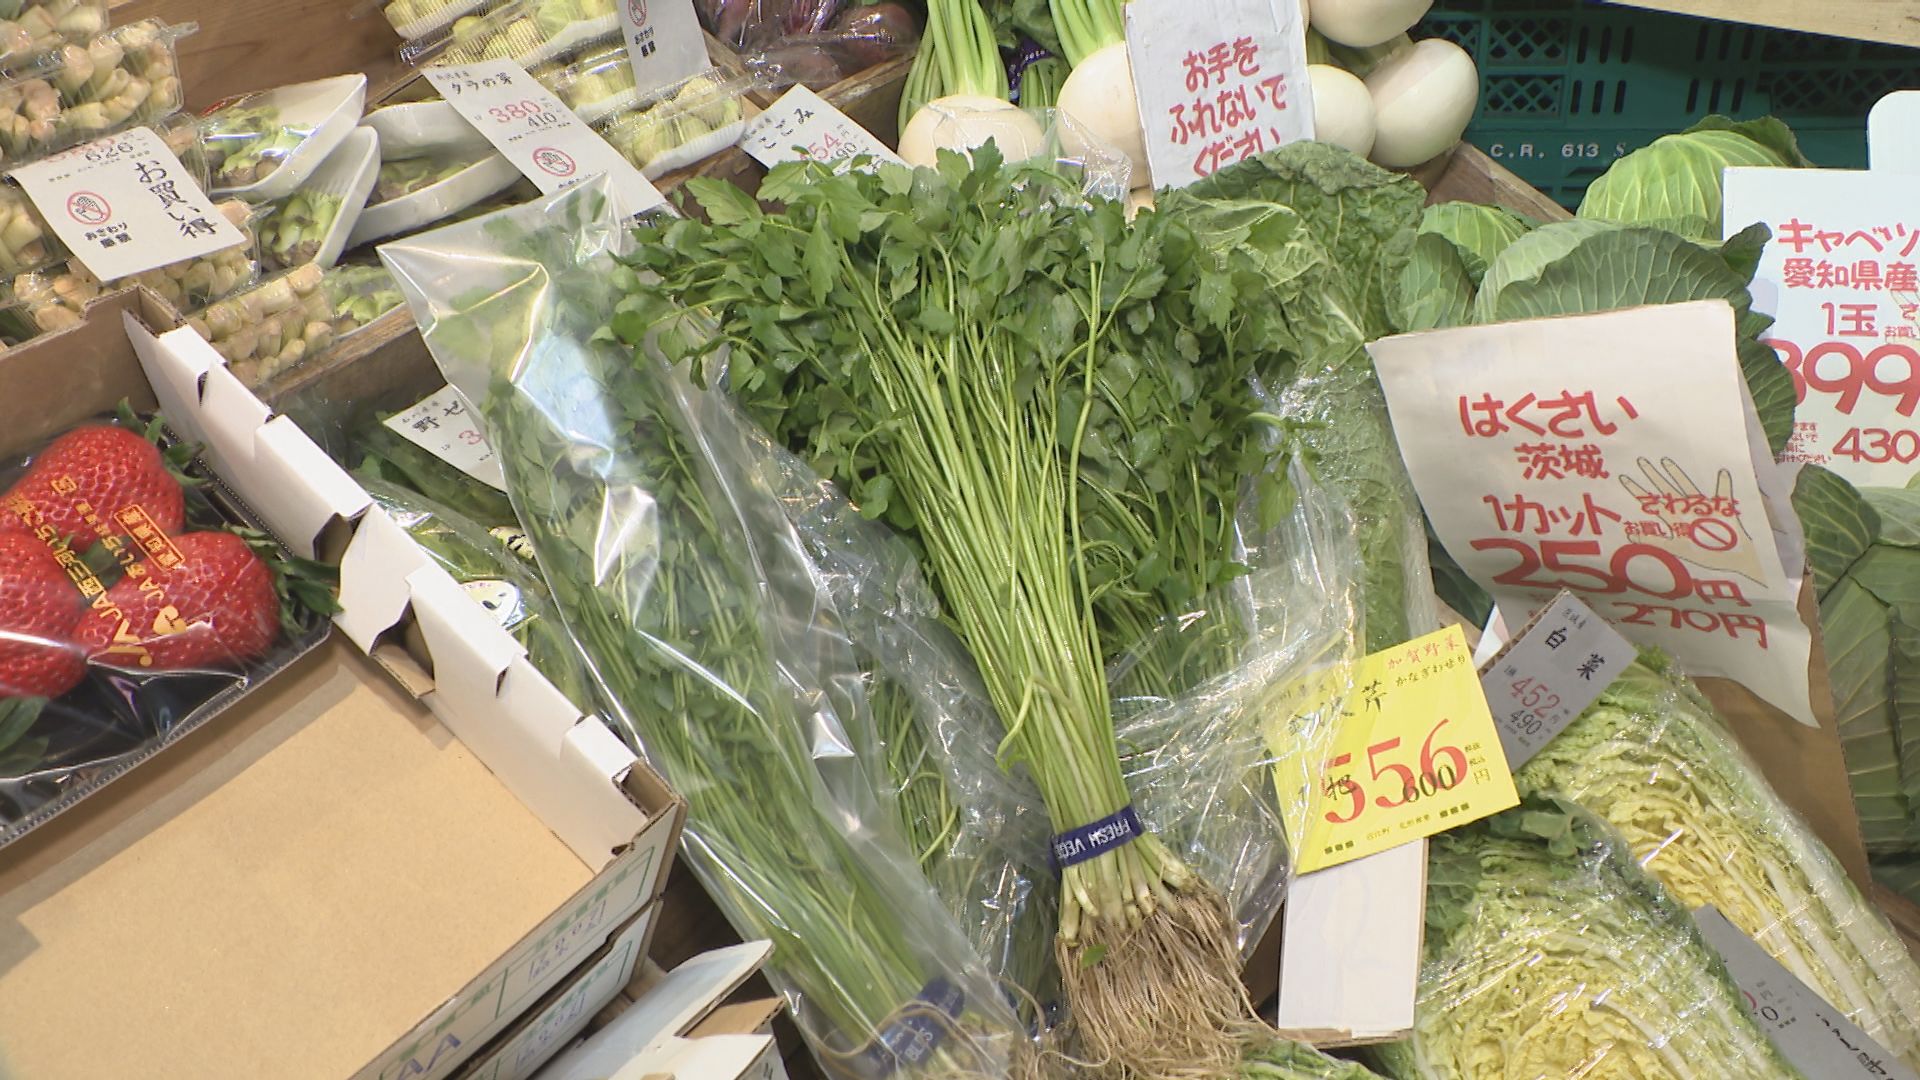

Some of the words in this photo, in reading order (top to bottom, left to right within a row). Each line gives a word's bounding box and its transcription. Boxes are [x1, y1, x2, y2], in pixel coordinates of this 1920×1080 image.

[1183, 36, 1260, 92] お手を
[488, 100, 541, 123] 380
[528, 112, 557, 129] 410
[1169, 73, 1287, 144] ふれないで
[1193, 127, 1281, 177] ください
[1490, 143, 1545, 158] C.R.
[1561, 143, 1599, 157] 613
[134, 160, 218, 239] お買い得
[1778, 218, 1920, 257] キャベツ
[1783, 258, 1919, 292] 愛知県産
[1821, 302, 1879, 337] 1玉
[1459, 390, 1639, 438] はくさい
[1513, 442, 1610, 480] 茨城
[1832, 427, 1920, 465] 430
[1483, 492, 1622, 536] 1カット
[1635, 492, 1742, 518] さわるな
[1469, 537, 1752, 607] 250円
[1611, 601, 1769, 650] 270円
[1388, 634, 1460, 669] 加賀野菜
[1545, 626, 1606, 681] 白菜
[1510, 675, 1561, 719] 452
[1510, 709, 1543, 735] 490
[1321, 718, 1468, 823] 556
[1403, 764, 1456, 803] 600
[1088, 818, 1131, 848] FRESH
